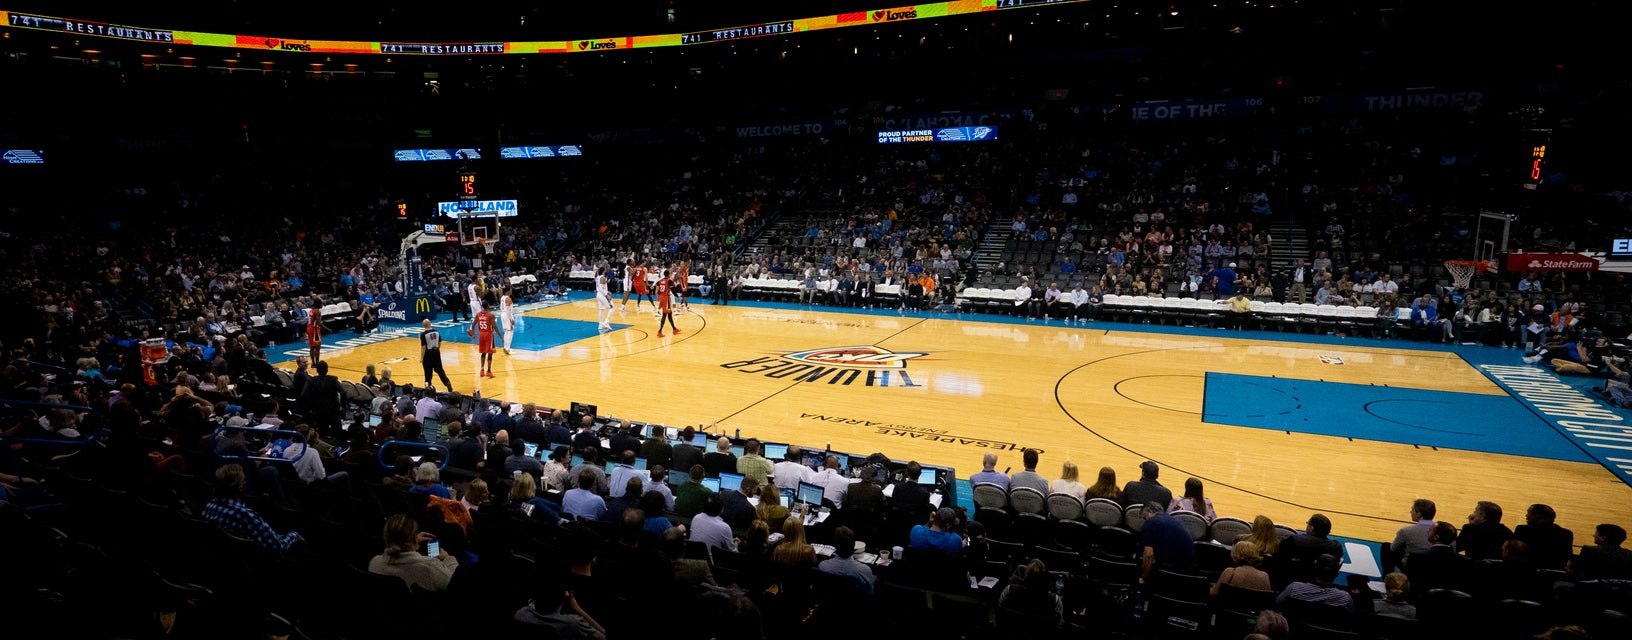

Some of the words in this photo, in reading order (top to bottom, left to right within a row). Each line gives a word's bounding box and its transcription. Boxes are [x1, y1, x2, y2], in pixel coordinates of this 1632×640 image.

[66, 22, 173, 42] RESTAURANTS
[683, 34, 701, 43] 741
[716, 23, 792, 39] RESTAURANTS
[422, 45, 503, 53] RESTAURANTS
[1155, 105, 1182, 119] OF
[736, 124, 801, 138] WELCOME
[804, 123, 824, 135] TO
[464, 182, 474, 195] 15
[378, 308, 406, 320] SPALDING
[479, 320, 488, 330] 55
[720, 356, 923, 388] THUNDER
[800, 412, 882, 428] ARENA
[887, 424, 949, 435] ENERGY
